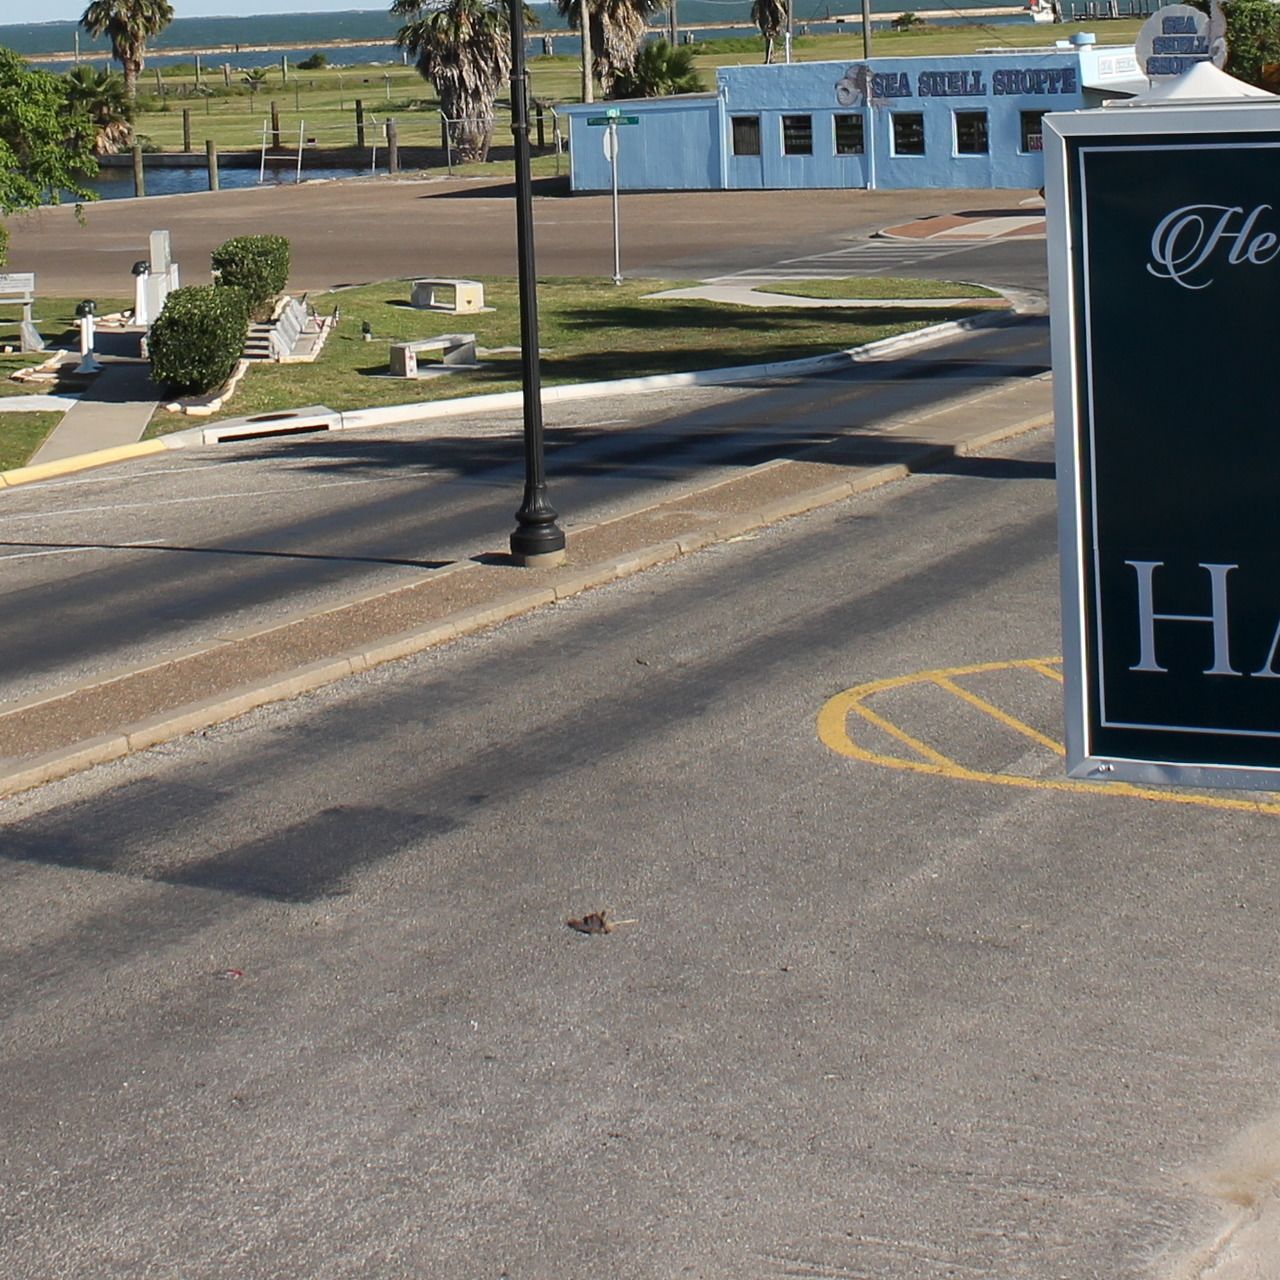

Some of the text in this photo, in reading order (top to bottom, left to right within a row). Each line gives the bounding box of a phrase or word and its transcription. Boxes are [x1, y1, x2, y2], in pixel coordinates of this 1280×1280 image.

[1162, 16, 1197, 35] SEA
[872, 68, 1077, 98] SEA SHELL SHOPPE
